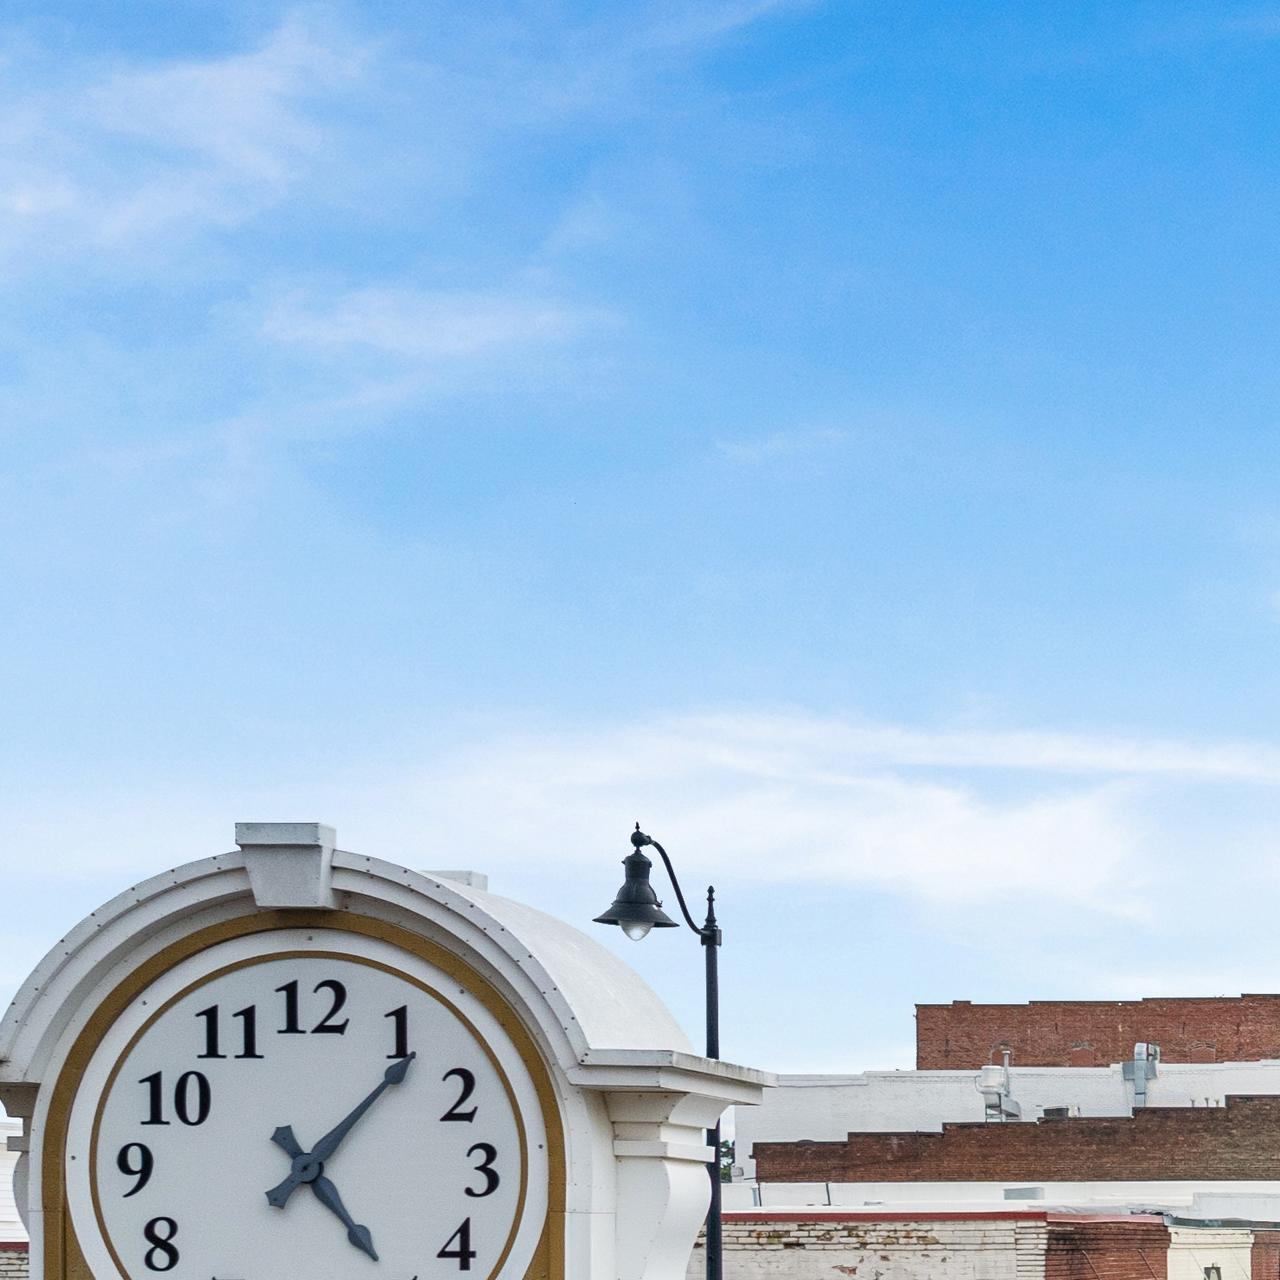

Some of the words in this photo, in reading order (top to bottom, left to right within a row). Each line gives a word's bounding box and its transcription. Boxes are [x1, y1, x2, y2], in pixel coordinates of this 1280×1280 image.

[195, 1005, 264, 1058] 11
[275, 980, 349, 1035] 12
[384, 1004, 415, 1059] 1
[139, 1070, 210, 1126] 10
[440, 1068, 478, 1122] 2
[117, 1143, 153, 1197] 9
[464, 1143, 500, 1198] 3
[143, 1216, 180, 1272] 8
[437, 1217, 476, 1271] 4
